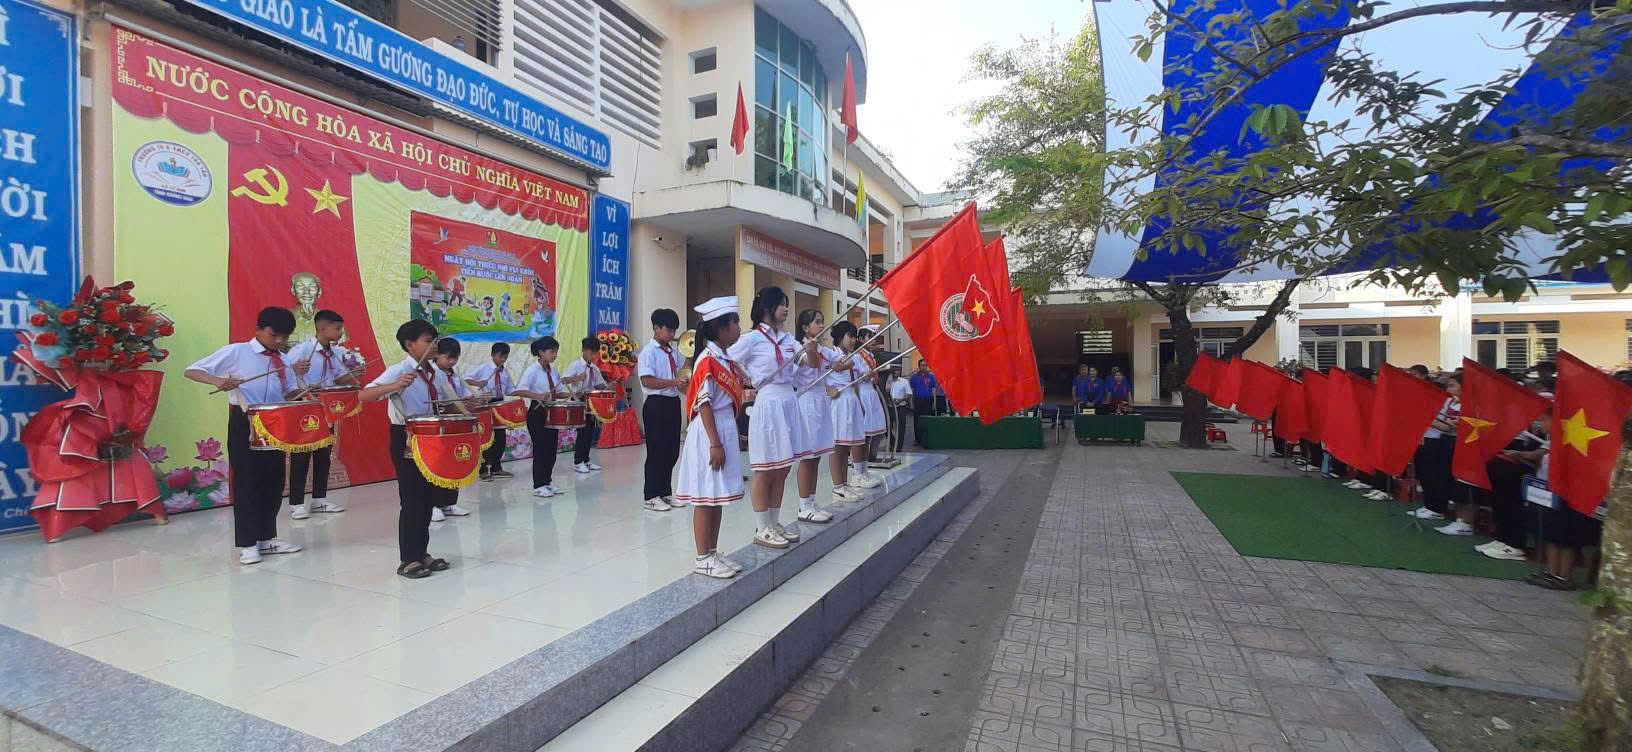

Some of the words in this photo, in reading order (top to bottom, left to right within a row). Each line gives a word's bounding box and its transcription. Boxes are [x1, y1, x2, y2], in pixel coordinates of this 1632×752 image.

[301, 7, 328, 45] LÀ
[333, 18, 373, 64] TẤM
[378, 43, 433, 89] GƯƠNG
[436, 68, 466, 105] ĐẠO
[469, 79, 500, 119] ĐỨC,
[503, 98, 519, 128] TỰ
[522, 107, 545, 136] HỌC
[547, 117, 562, 143] VÀ
[563, 125, 588, 155] SÁNG
[590, 139, 607, 165] TẠO
[145, 55, 230, 101] NƯỚC
[238, 87, 309, 127] CỘNG
[316, 111, 362, 144] HÒA
[367, 129, 396, 155] XÃ
[401, 140, 433, 166] HỘI
[438, 153, 471, 177] CHỦ
[476, 165, 520, 192] NGHĨA
[523, 180, 552, 201] VIỆT
[555, 190, 579, 208] NAM
[606, 203, 616, 223] VÌ
[602, 231, 619, 251] LỢI
[602, 254, 619, 275] ÍCH
[595, 281, 622, 301] TRĂM
[599, 307, 620, 325] NĂM
